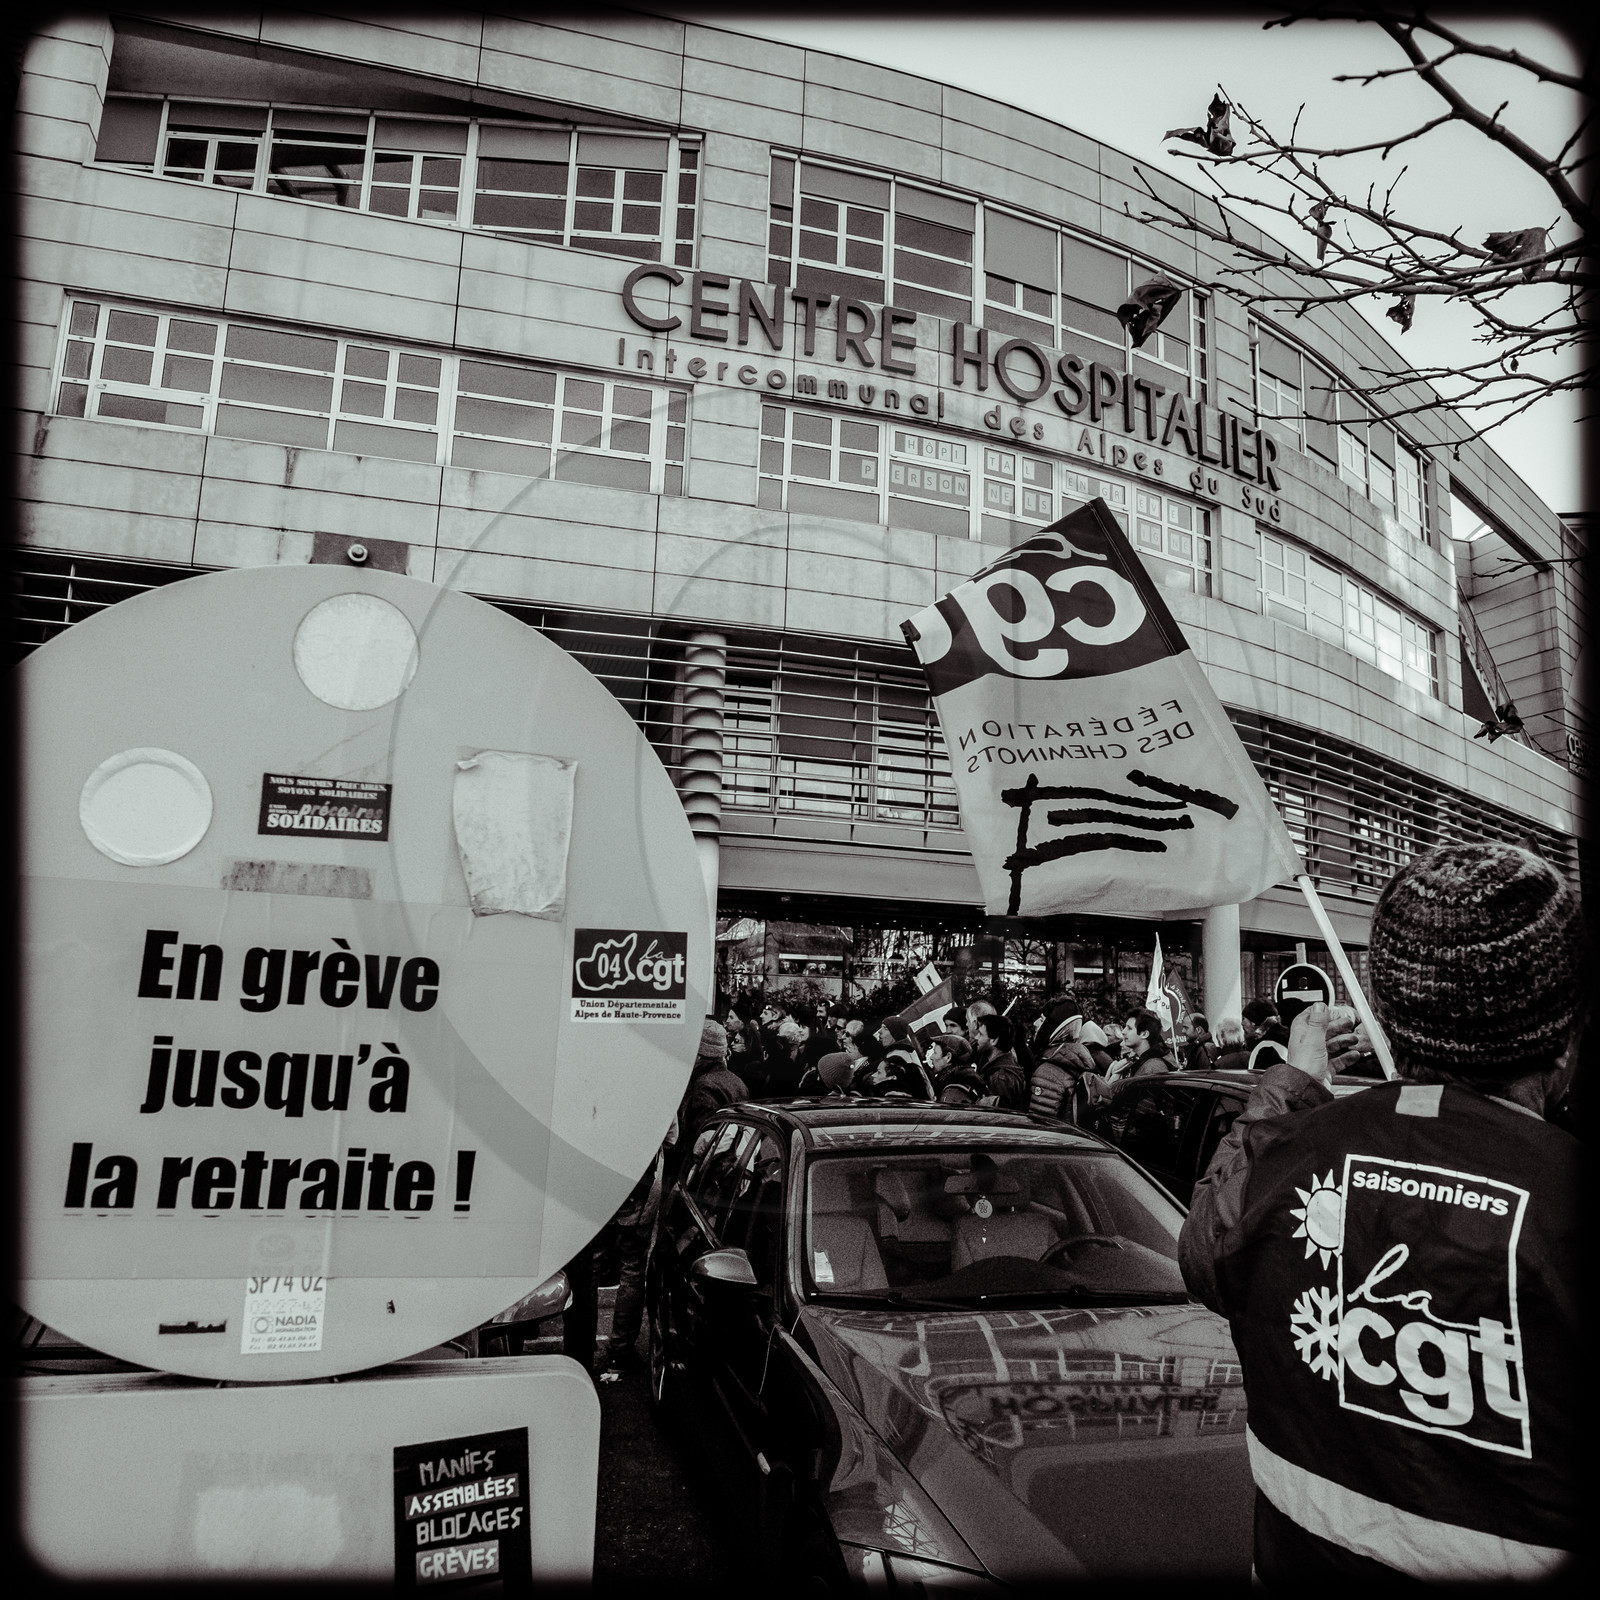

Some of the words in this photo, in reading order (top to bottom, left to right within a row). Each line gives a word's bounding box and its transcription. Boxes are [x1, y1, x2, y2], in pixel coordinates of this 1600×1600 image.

[622, 264, 917, 375] CENTRE
[953, 321, 1281, 492] HOSPITALIER
[618, 338, 945, 418] Intercommunal
[984, 405, 1045, 440] des
[1077, 428, 1164, 476] Alpes
[1190, 467, 1219, 496] du
[1242, 485, 1281, 523] Sud
[1068, 477, 1087, 491] EN
[267, 813, 383, 833] SOLIDAIRES
[299, 801, 384, 819] précaires
[137, 929, 224, 1001] En
[239, 938, 440, 1013] grève
[597, 953, 621, 978] 04
[636, 953, 685, 991] cgt
[575, 1010, 599, 1019] Alpes
[602, 1010, 612, 1018] de
[614, 1011, 681, 1019] Haute-Provence
[580, 1000, 605, 1008] Union
[607, 1000, 677, 1009] Départementale
[139, 1035, 411, 1118] jusqu'à
[63, 1142, 139, 1210] la
[156, 1147, 436, 1213] retraite
[1352, 1170, 1509, 1216] saisonniers
[1347, 1243, 1479, 1331] la
[275, 1315, 317, 1326] NADIA
[1337, 1307, 1529, 1426] cgt
[409, 1477, 516, 1516] ASSEMBLÉES
[416, 1506, 523, 1545] BLOCAGES
[419, 1547, 498, 1579] GRÈVES
